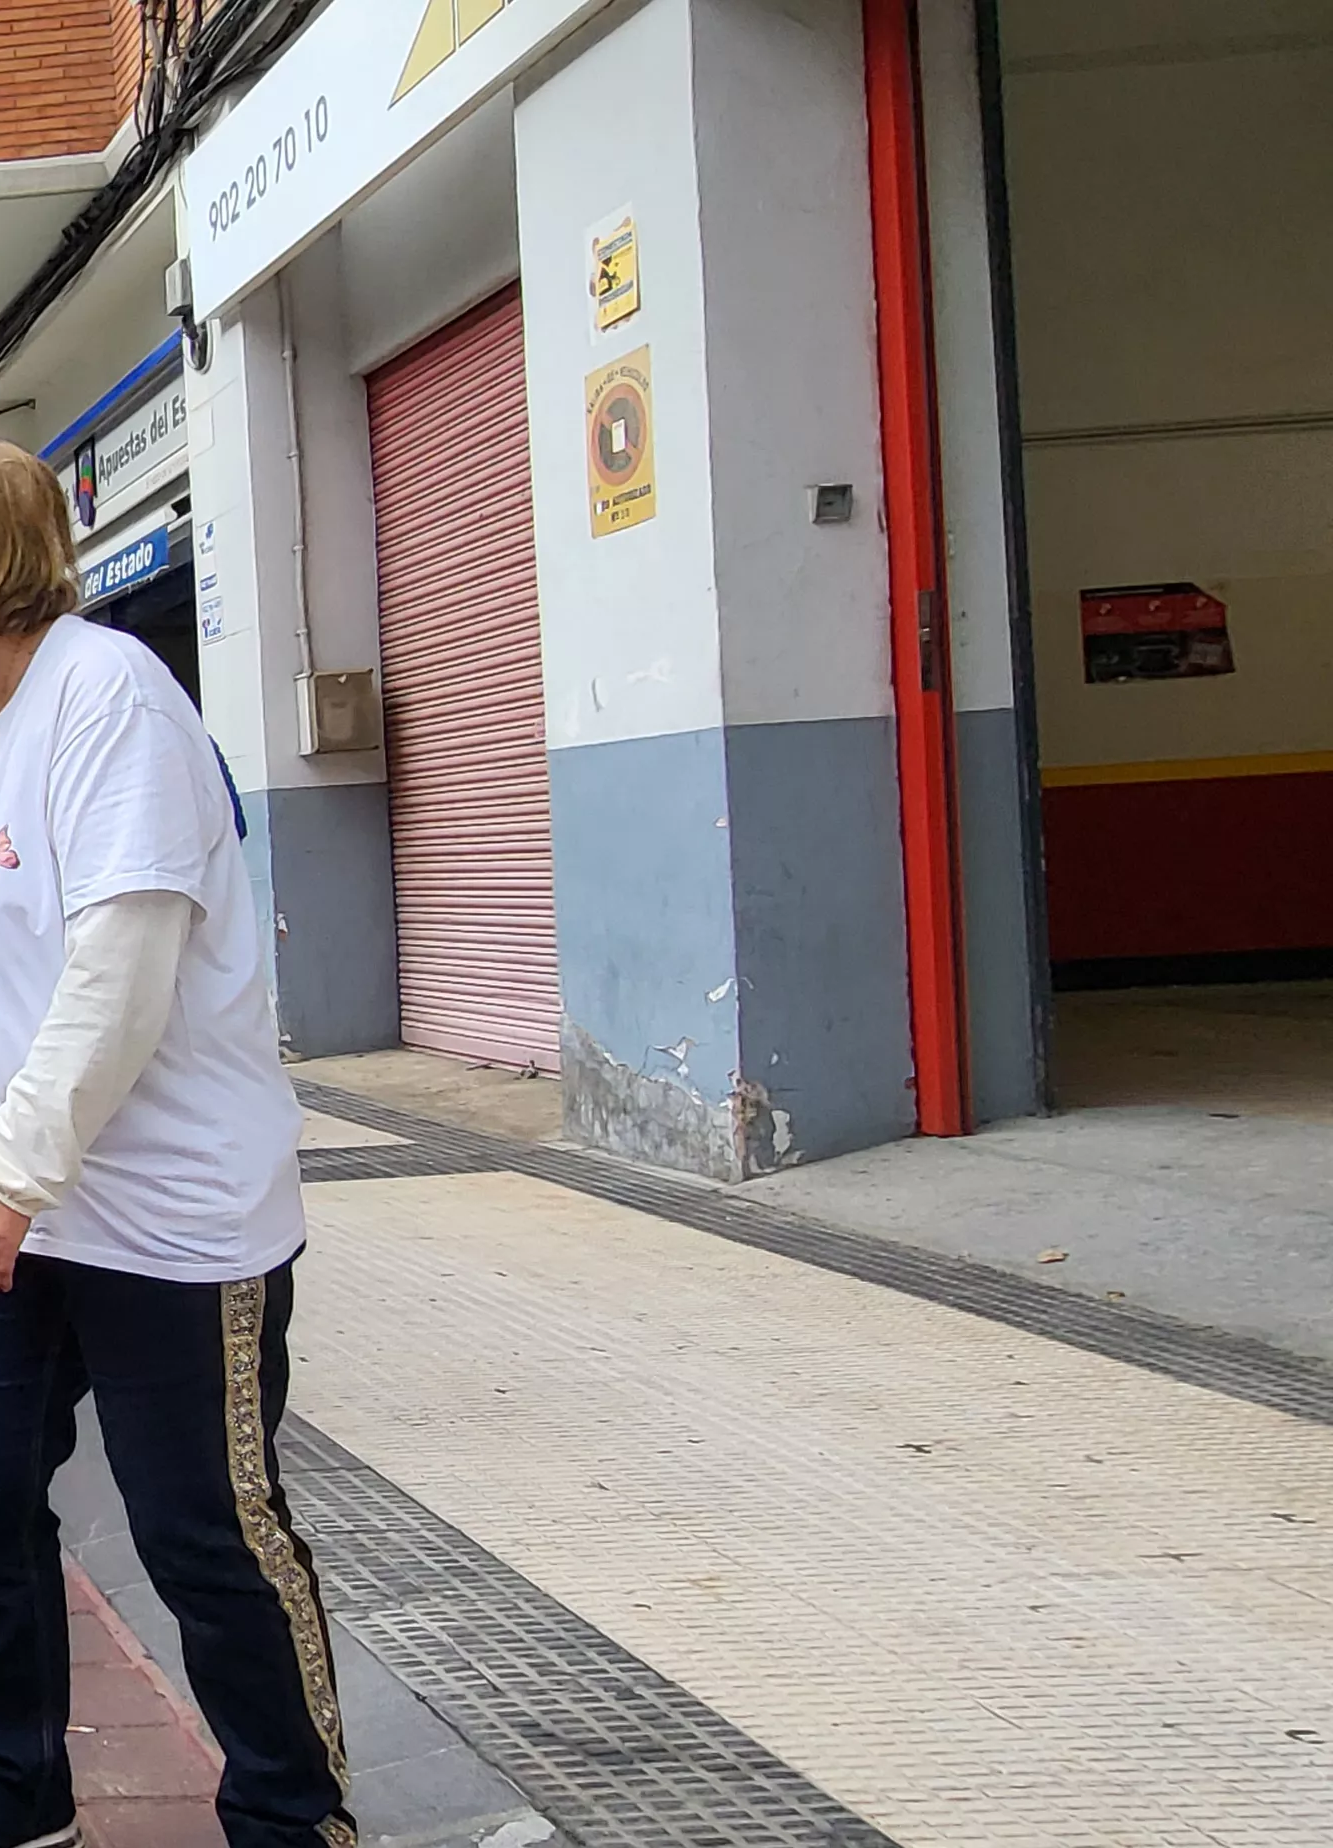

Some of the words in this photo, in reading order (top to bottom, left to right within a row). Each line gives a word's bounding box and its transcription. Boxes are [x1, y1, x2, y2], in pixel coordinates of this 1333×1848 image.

[209, 181, 240, 242] 902
[244, 165, 267, 210] 20
[272, 126, 296, 184] 70
[304, 95, 328, 153] 10
[98, 428, 148, 486] Apuestas
[150, 401, 168, 445] del
[84, 565, 104, 599] del
[105, 541, 153, 588] Estado
